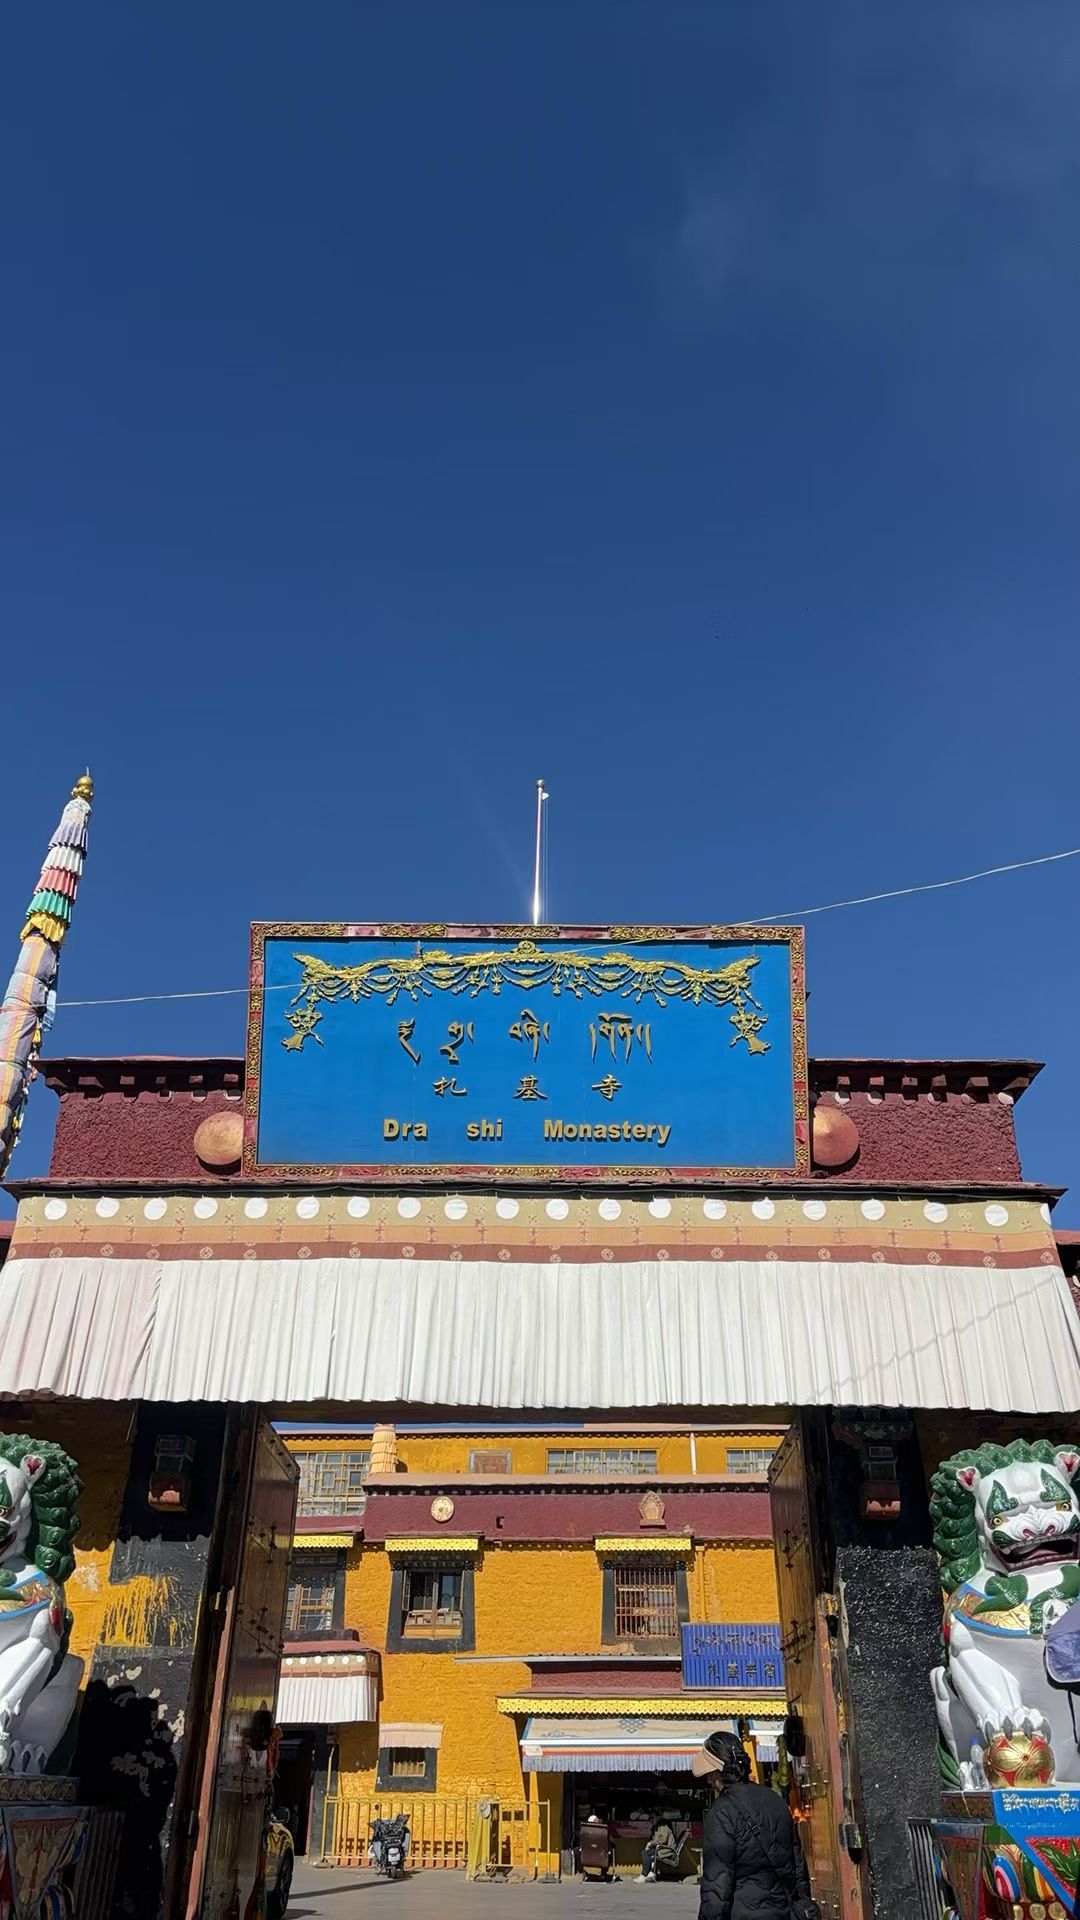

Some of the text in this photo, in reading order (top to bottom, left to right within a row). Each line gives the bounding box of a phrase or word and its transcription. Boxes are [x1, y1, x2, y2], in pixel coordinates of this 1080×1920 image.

[431, 1074, 623, 1100] 扎基寺
[383, 1119, 671, 1145] Dra shi Monastery
